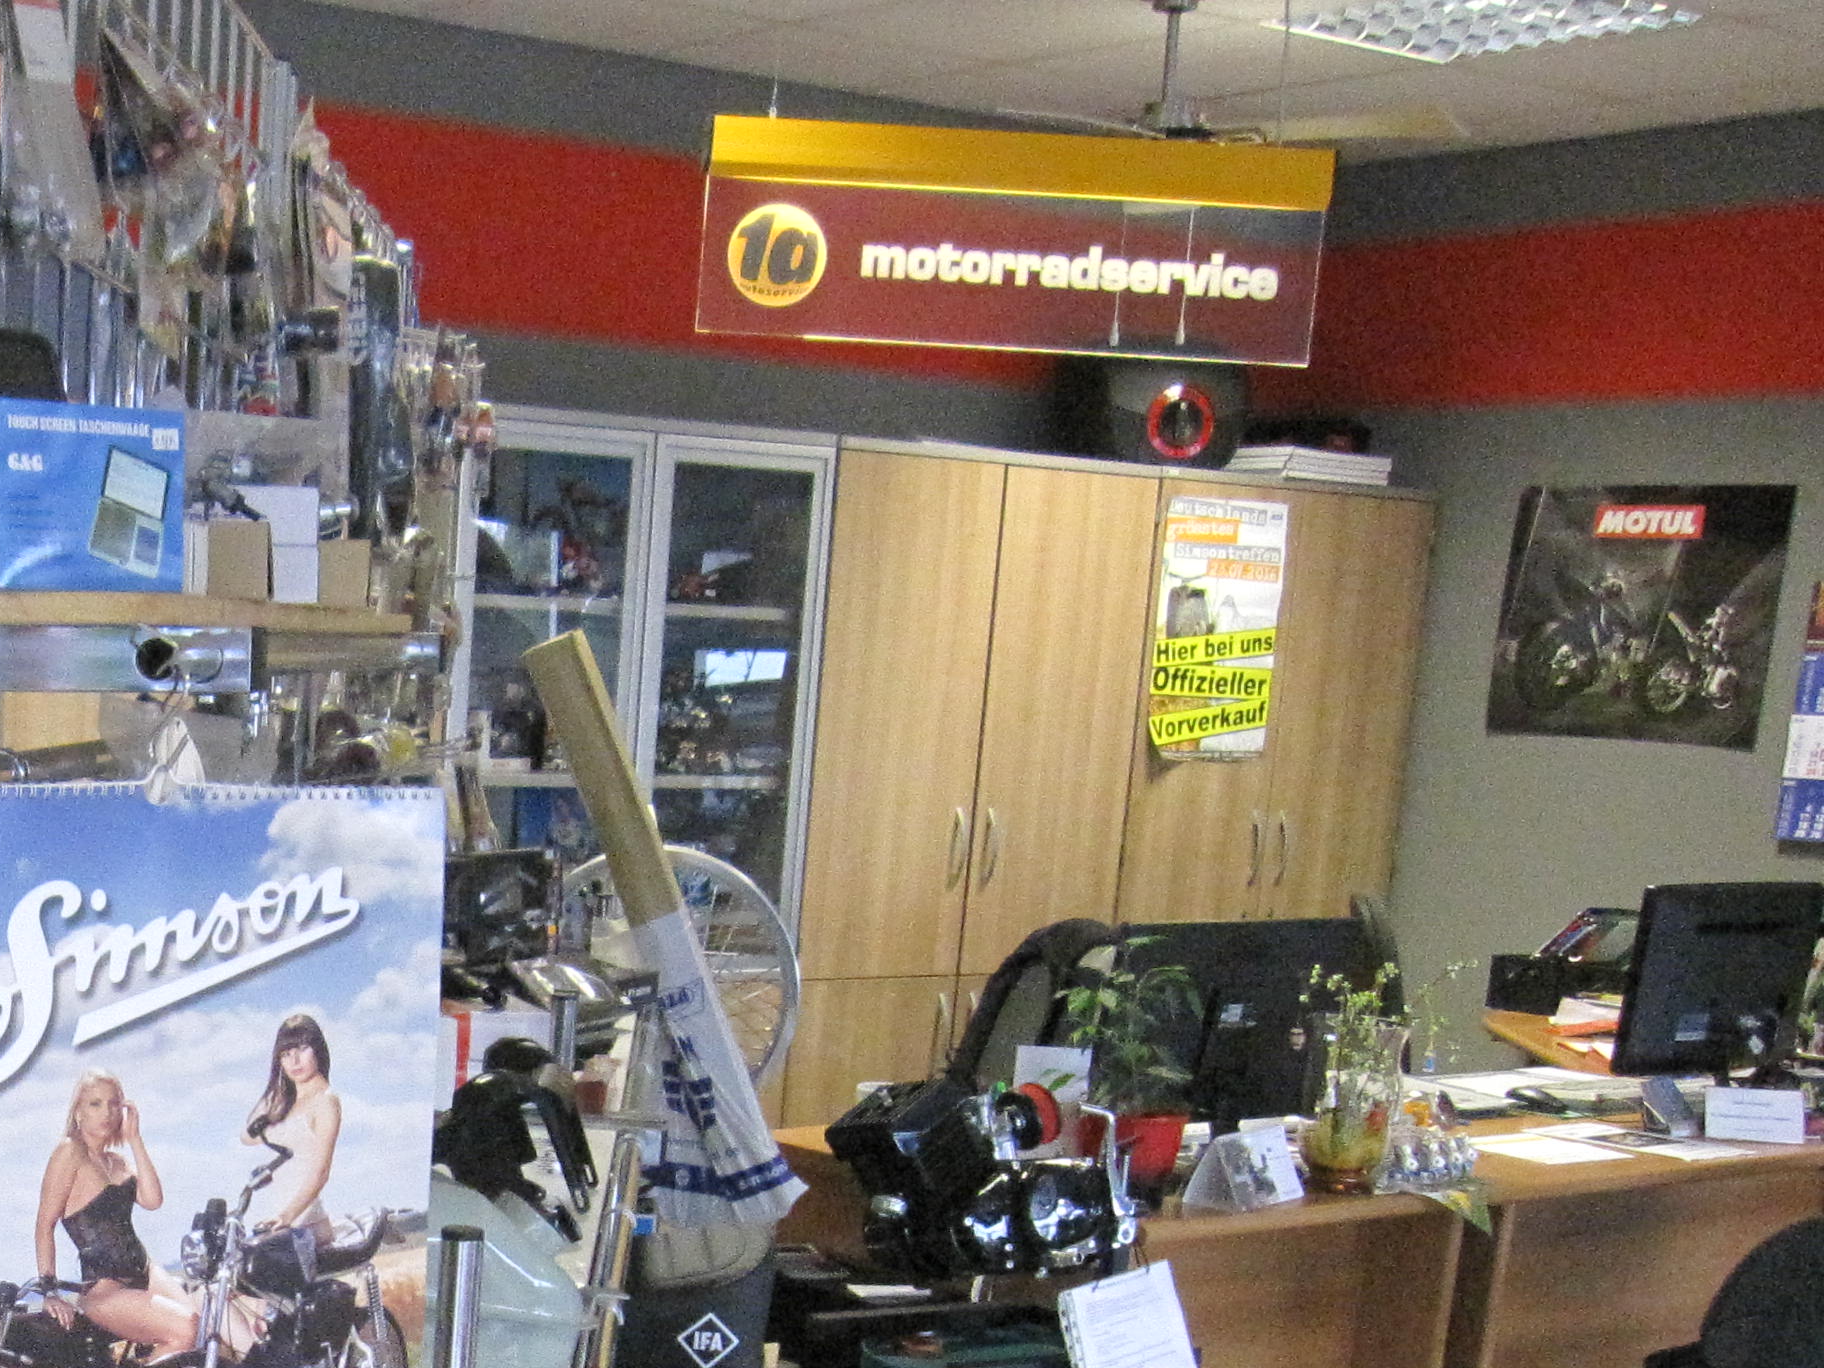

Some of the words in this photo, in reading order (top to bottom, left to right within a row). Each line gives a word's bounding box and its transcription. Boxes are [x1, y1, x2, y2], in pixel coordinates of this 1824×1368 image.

[860, 242, 1279, 301] motorradservice
[1596, 510, 1697, 535] MOTUL
[1156, 640, 1198, 663] Hier
[1204, 635, 1234, 658] bei
[1240, 635, 1273, 653] uns
[1152, 666, 1268, 697] Offizieller
[1151, 700, 1267, 740] Vorverkauf
[692, 1330, 724, 1352] IFA
